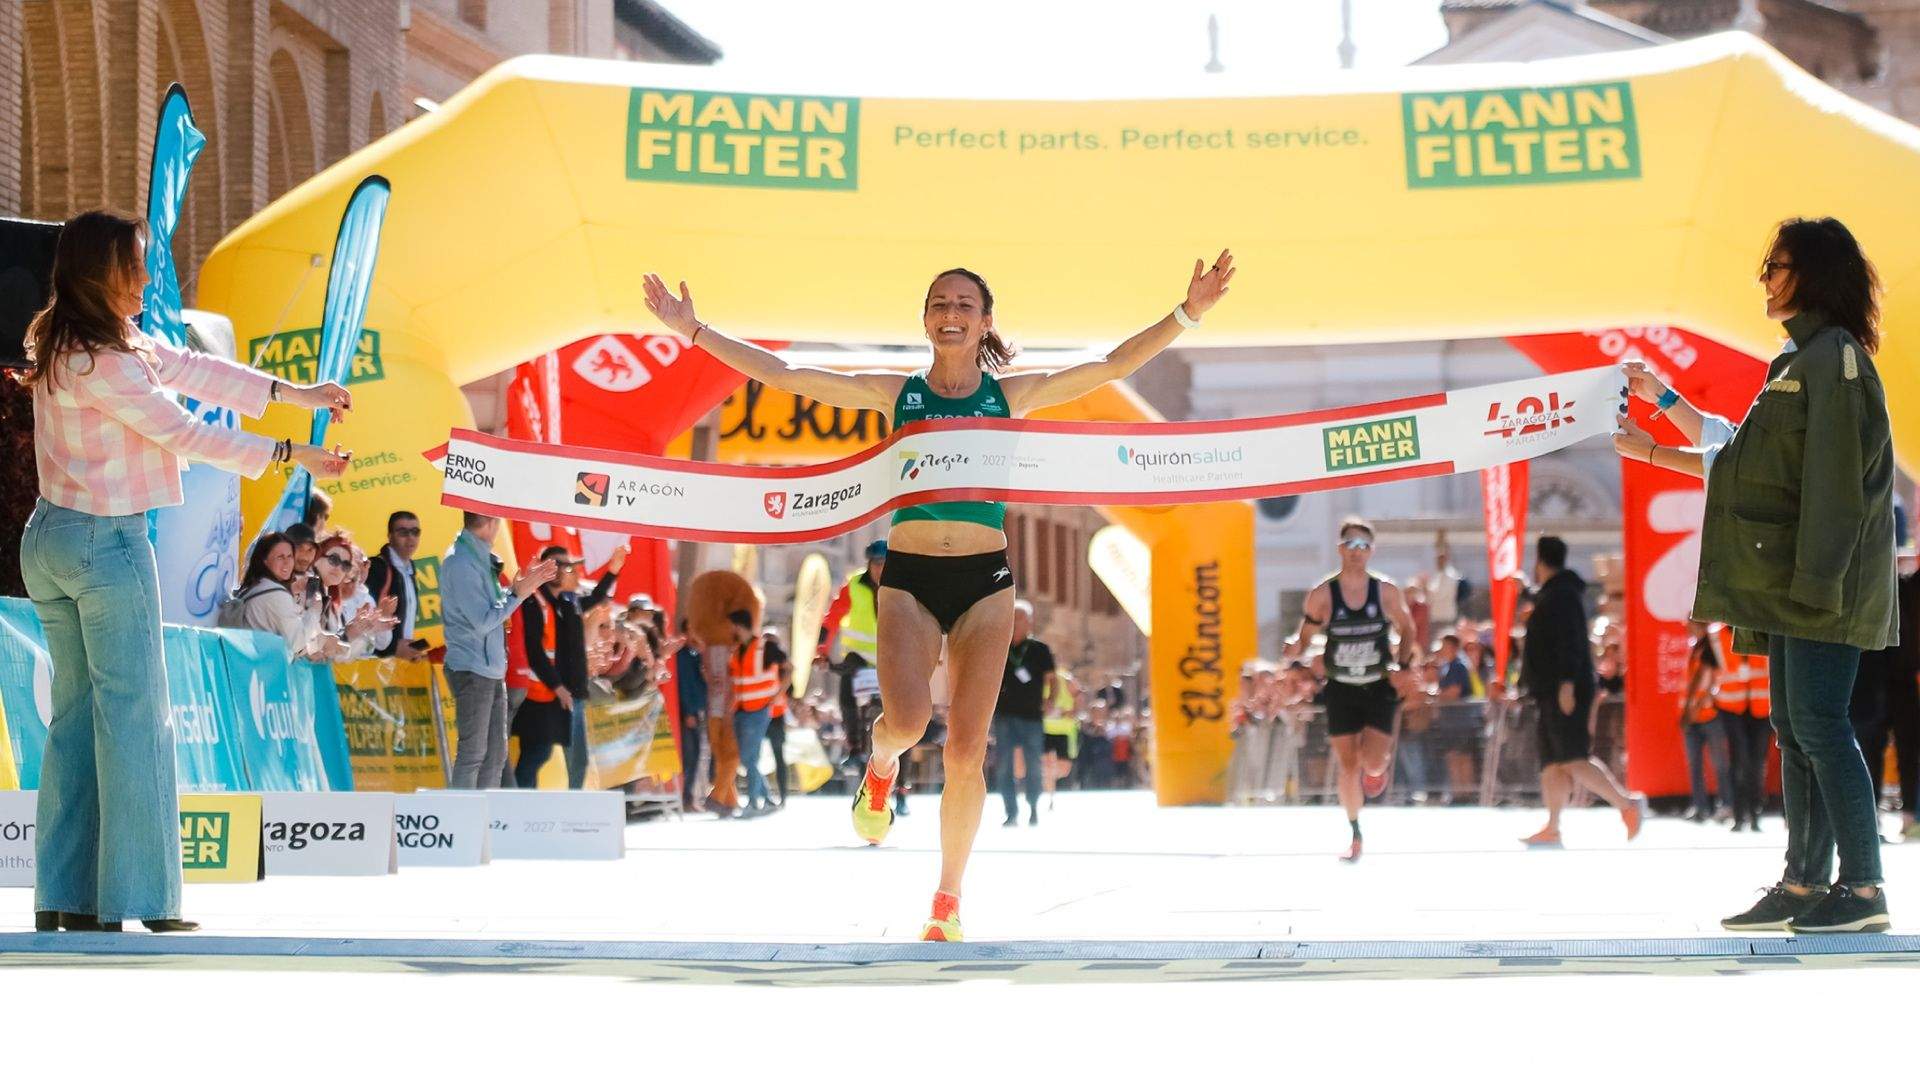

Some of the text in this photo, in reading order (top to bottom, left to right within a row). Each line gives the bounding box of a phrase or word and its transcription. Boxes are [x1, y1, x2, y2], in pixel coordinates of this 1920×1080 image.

[640, 92, 848, 134] MANN
[1413, 88, 1624, 132] MANN
[637, 128, 848, 180] FILTER
[895, 125, 1369, 155] Perfect parts. Perfect service.
[1416, 127, 1630, 179] FILTER
[255, 333, 374, 367] MAN
[1501, 411, 1561, 428] ZARAGOZA
[1328, 420, 1413, 449] MANN
[446, 453, 486, 473] ERNO
[982, 454, 1007, 467] 2027
[1330, 439, 1415, 468] FILTER
[350, 471, 417, 492] service.
[444, 466, 495, 489] RAGON
[1153, 471, 1243, 484] Healthcare Partner
[616, 495, 636, 507] TV
[792, 482, 862, 510] Zaragoza
[1180, 689, 1225, 728] El
[523, 821, 556, 833] 2027
